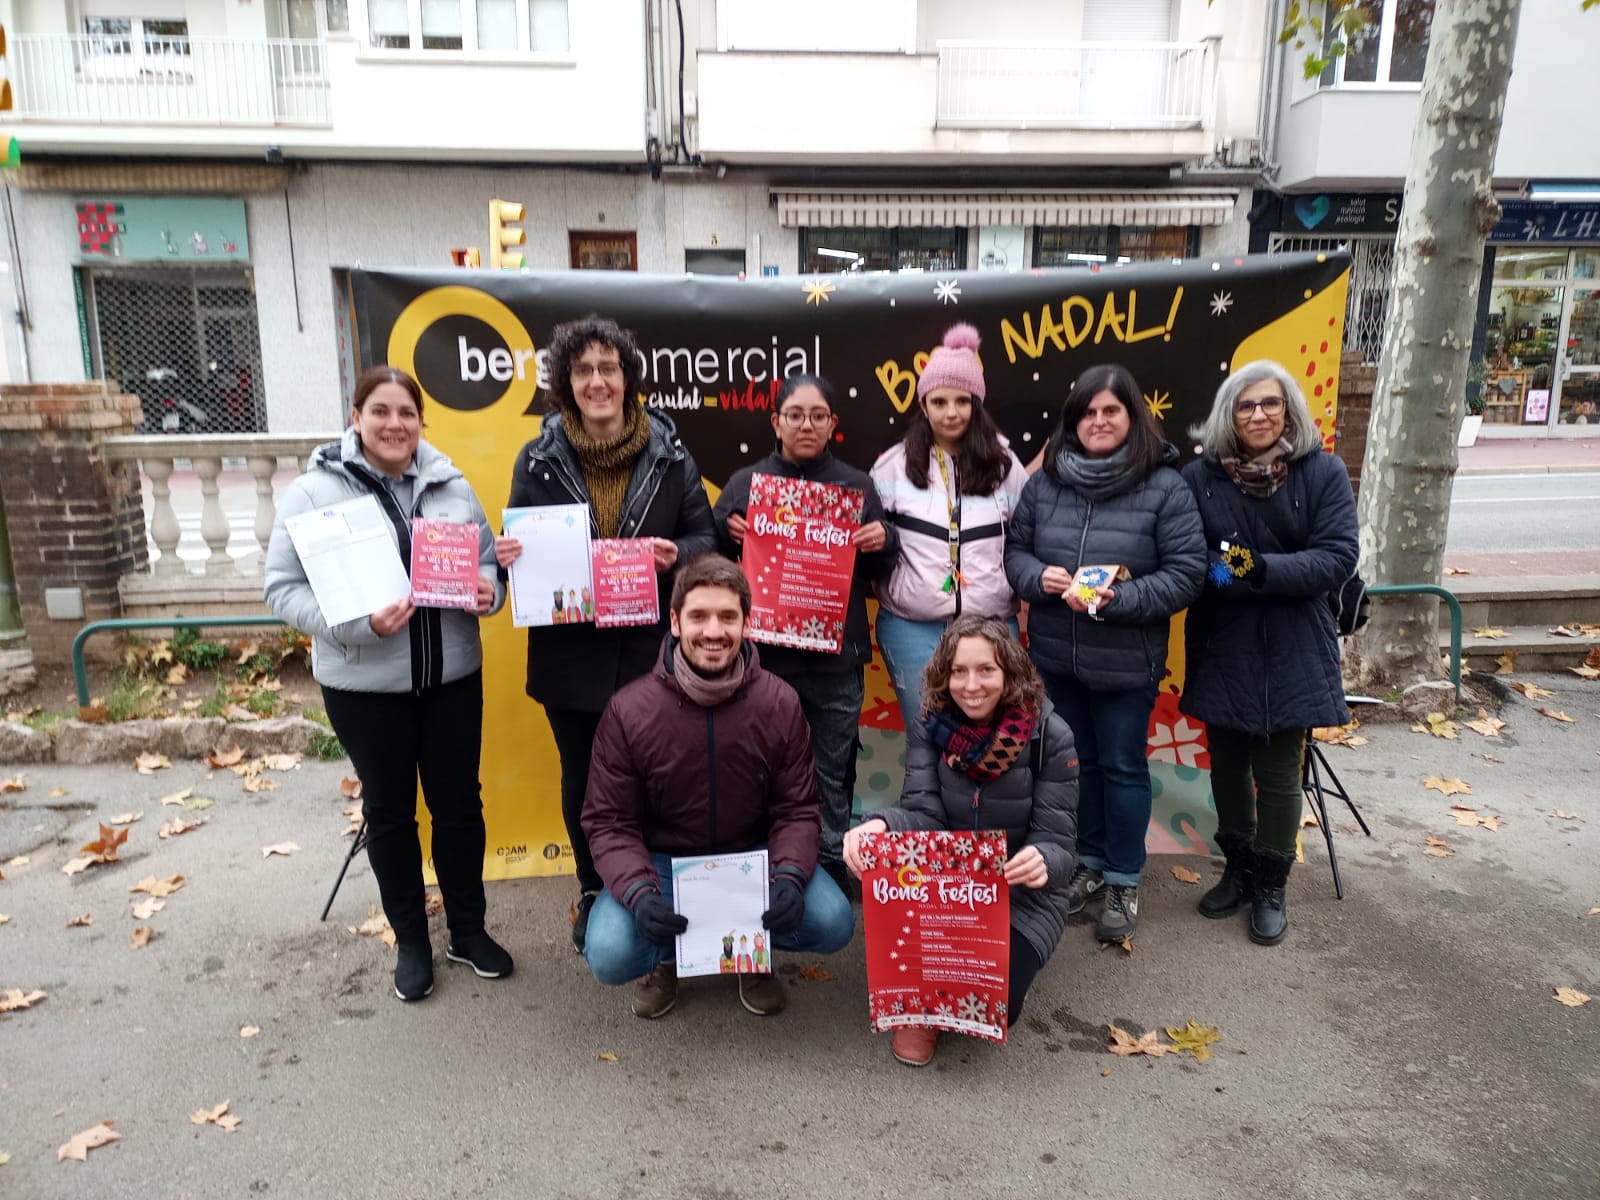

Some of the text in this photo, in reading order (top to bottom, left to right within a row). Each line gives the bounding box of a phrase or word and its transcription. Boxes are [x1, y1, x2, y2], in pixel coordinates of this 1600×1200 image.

[1552, 211, 1600, 238] L'H
[1001, 285, 1185, 364] NADAL!
[458, 335, 820, 390] berg omercial
[754, 513, 851, 550] Bones Festes!
[873, 877, 998, 911] Bones Festes!
